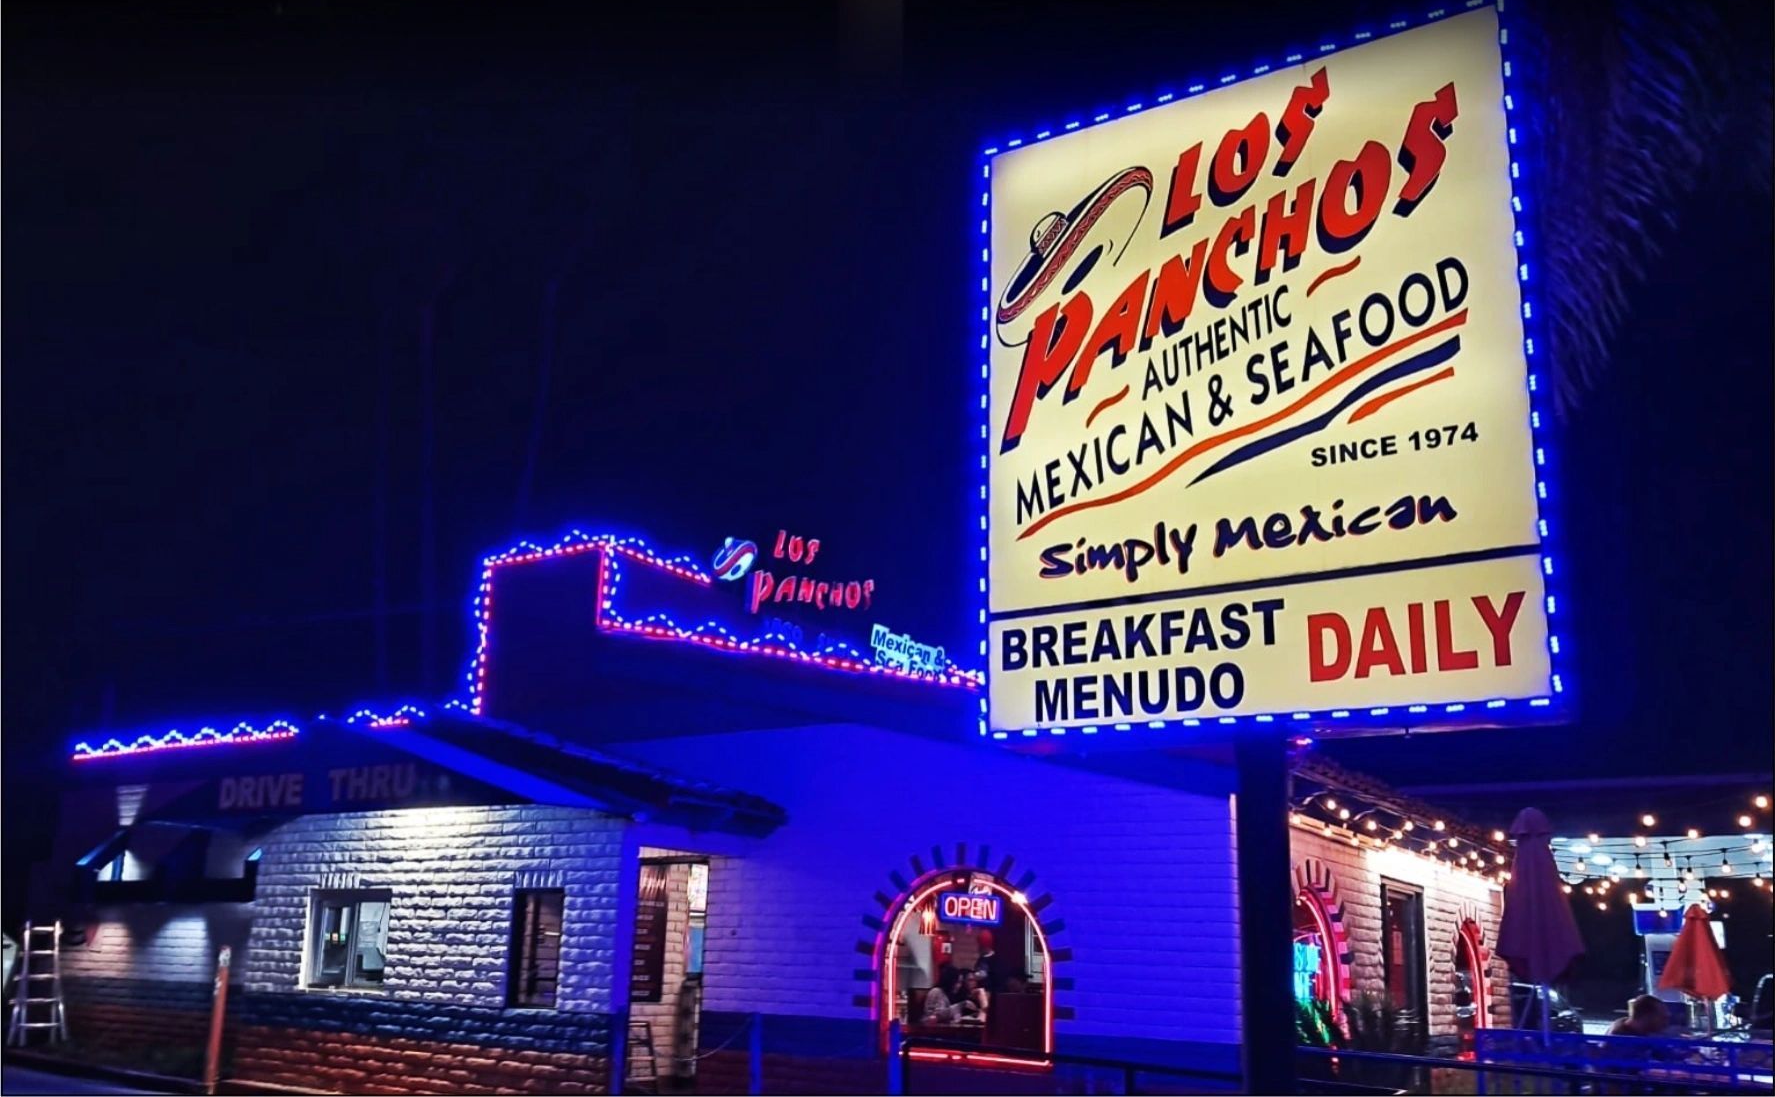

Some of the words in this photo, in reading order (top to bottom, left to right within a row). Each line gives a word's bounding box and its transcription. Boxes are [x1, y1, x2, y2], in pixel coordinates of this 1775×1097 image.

[1160, 65, 1330, 239] LOS
[999, 81, 1459, 456] PANCHOS
[1142, 284, 1292, 401] AUTHENTIC
[1016, 391, 1194, 525] MEXICAN
[1208, 374, 1234, 428] &
[1246, 256, 1470, 405] SEAFOOD
[1311, 435, 1398, 468] SINCE
[1408, 421, 1480, 452] 1974
[773, 529, 820, 564] LOS
[1039, 521, 1197, 583] Simply
[751, 569, 875, 614] PANCHOS
[873, 629, 931, 665] Mexican
[934, 649, 944, 667] &
[1001, 599, 1285, 672] BREAKFAST
[1307, 591, 1527, 683] DAILY
[1035, 663, 1245, 723] MENUDO
[219, 772, 304, 810] DRIVE
[327, 763, 418, 801] THRU
[944, 896, 998, 921] OPEN
